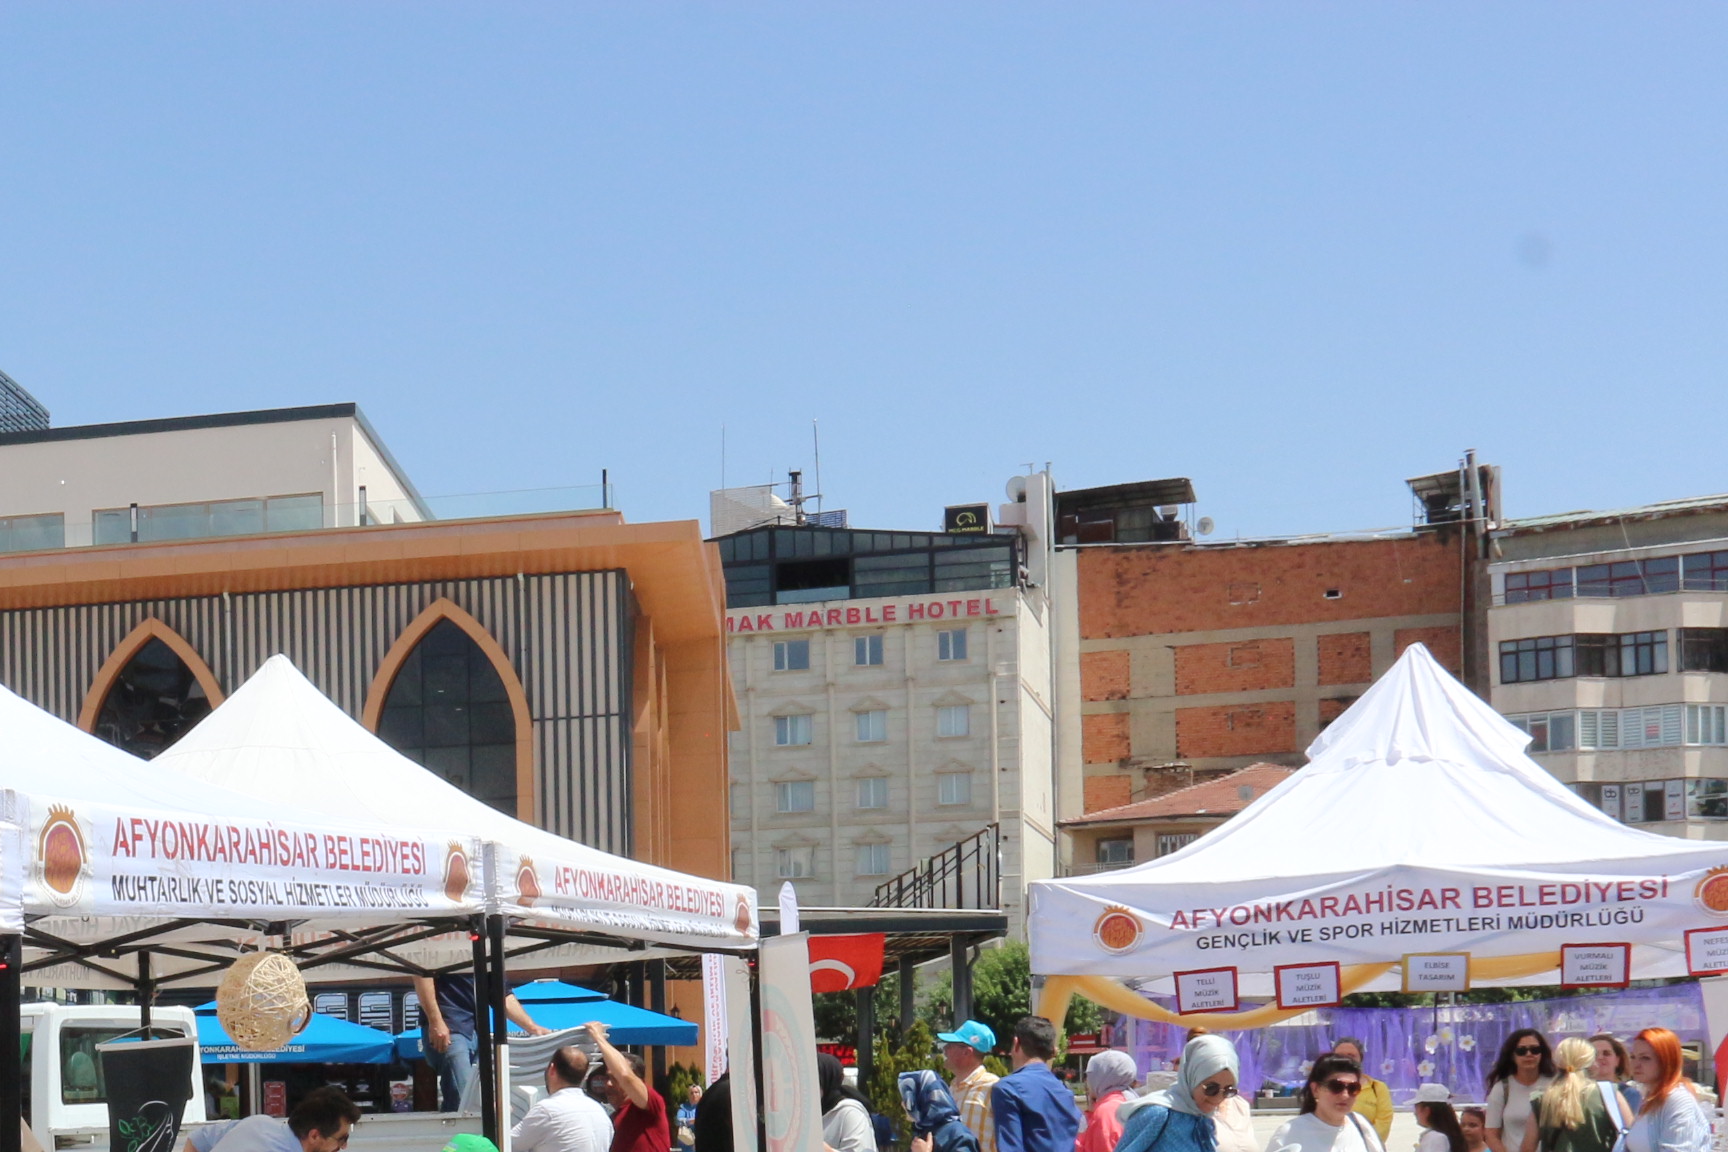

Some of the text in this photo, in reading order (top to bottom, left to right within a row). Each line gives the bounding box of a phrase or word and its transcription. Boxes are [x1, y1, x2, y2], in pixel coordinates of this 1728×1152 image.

[785, 603, 896, 629] MARBLE
[908, 597, 999, 620] HOTEL
[112, 816, 428, 876] AFYONKARAHİSAR BELEDİYESİ
[111, 874, 206, 903] MUHTARLIK
[207, 878, 226, 905] VE
[229, 877, 284, 906] SOSYAL
[284, 876, 352, 908] HİZMETLER
[353, 880, 430, 909] MÜDÜRLÜĞÜ
[555, 865, 726, 918] AFYONKARAHİSAR BELEDİYESİ
[1169, 874, 1669, 931] AFYONKARAHİSAR BELEDİYESİ
[1196, 905, 1645, 951] GENÇLİK VE SPOR HİZMETLERİ MÜDÜRLÜĞÜ
[1194, 987, 1220, 998] MÜZİK
[1196, 977, 1216, 986] TELLİ
[1295, 981, 1322, 992] MÜZİK
[1191, 998, 1224, 1009] ALETLERİ
[1292, 993, 1327, 1004] ALETLERİ
